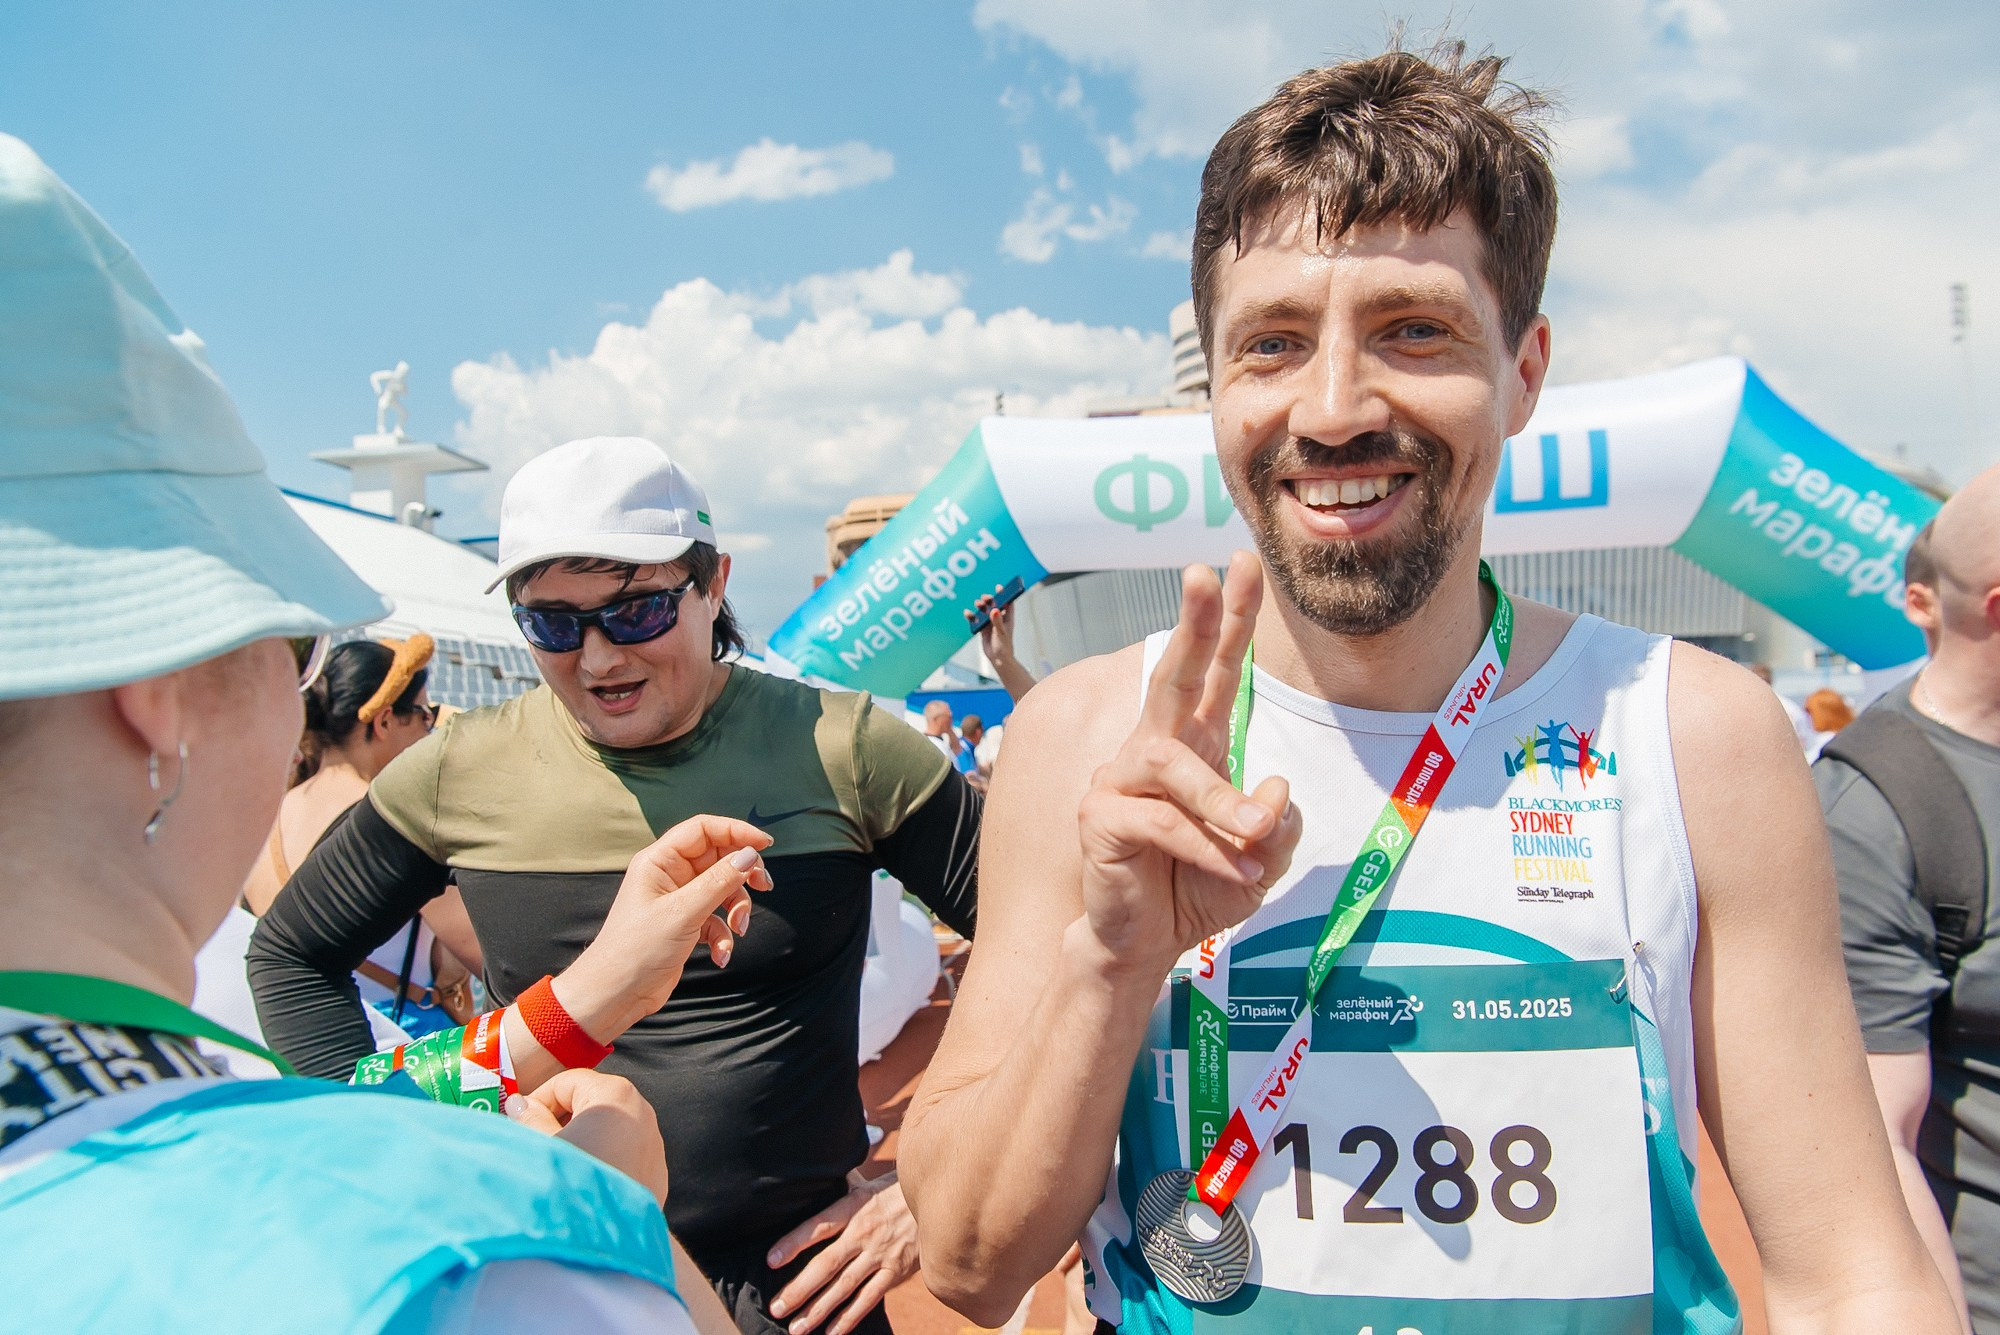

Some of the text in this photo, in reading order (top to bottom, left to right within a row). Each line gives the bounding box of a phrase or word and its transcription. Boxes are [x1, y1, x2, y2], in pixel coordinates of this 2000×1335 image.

[1768, 452, 1915, 551] зелён
[818, 496, 970, 642] зелёный
[840, 528, 1000, 671] марафон
[1443, 682, 1467, 721] AIRLINES
[1450, 662, 1498, 727] URAL
[1405, 751, 1443, 807] 80 ПОБЕДА!
[1508, 797, 1623, 812] BLACKMORES
[1509, 811, 1574, 835] SYDNEY
[1512, 834, 1592, 859] RUNNING
[1352, 850, 1386, 900] СБЕР
[1514, 858, 1593, 883] FESTIVAL
[1550, 887, 1594, 900] Telegraph
[1241, 1005, 1287, 1018] Прайм
[1330, 1010, 1389, 1023] марафон
[1336, 996, 1393, 1009] зелёный
[1452, 997, 1572, 1020] 31.05.2025
[1197, 1039, 1207, 1095] зелёный
[1208, 1045, 1220, 1103] марафон
[1250, 1065, 1277, 1105] AIRLINES
[1258, 1037, 1309, 1112] URAL
[1205, 1137, 1248, 1198] 80 ПОБЕДА!
[1273, 1123, 1557, 1224] 1288
